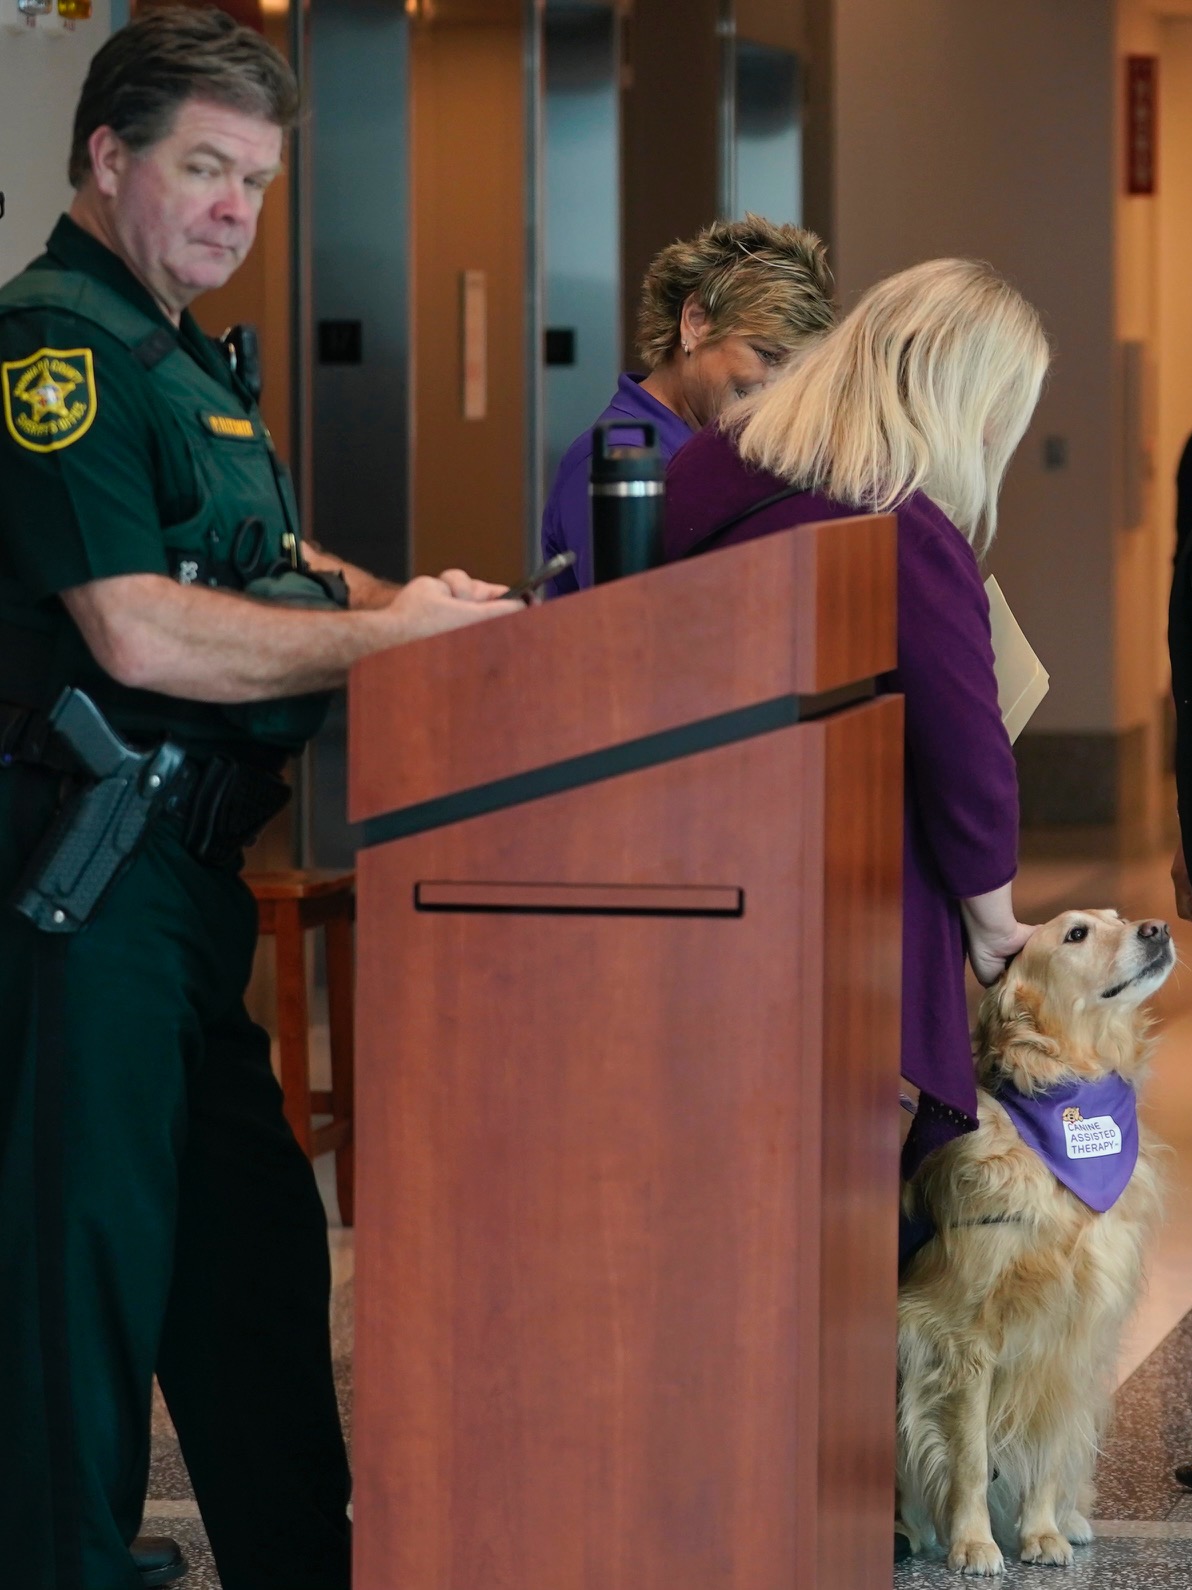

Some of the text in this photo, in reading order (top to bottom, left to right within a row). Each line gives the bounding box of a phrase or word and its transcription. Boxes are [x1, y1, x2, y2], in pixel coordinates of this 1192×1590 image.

[1067, 1122, 1101, 1132] CANINE
[1070, 1129, 1116, 1143] ASSISTED
[1071, 1141, 1114, 1154] THERAPY
